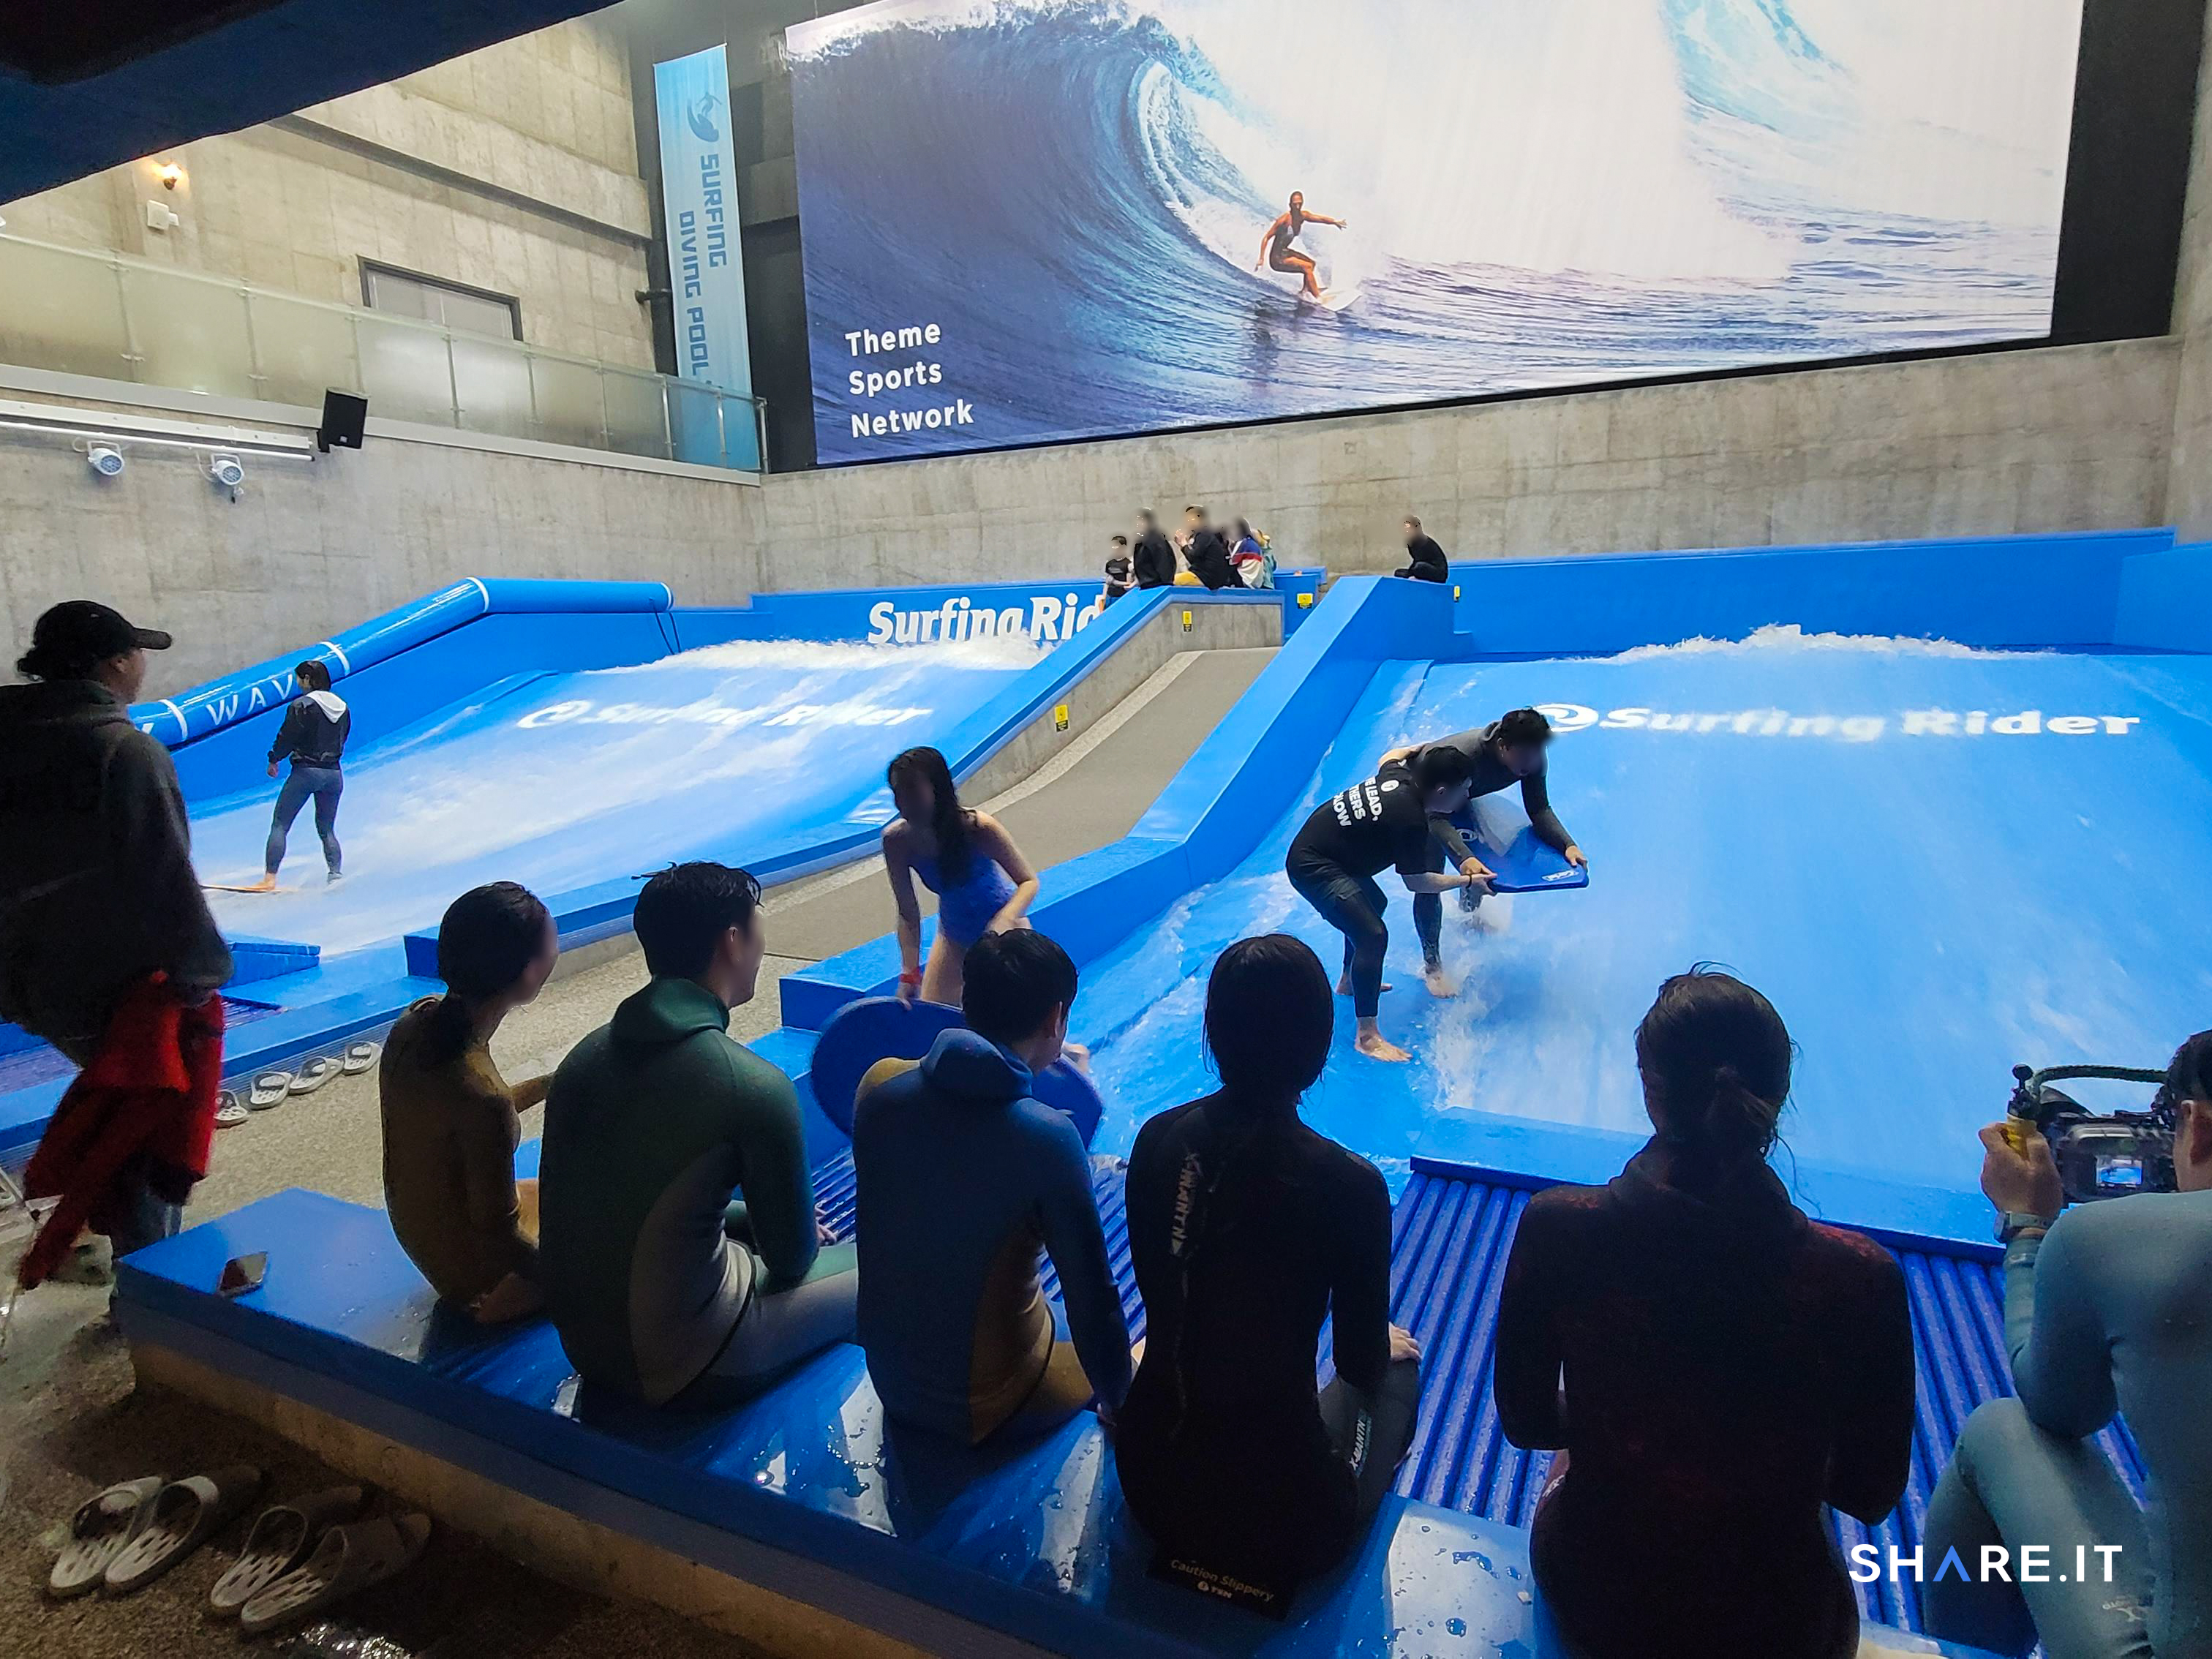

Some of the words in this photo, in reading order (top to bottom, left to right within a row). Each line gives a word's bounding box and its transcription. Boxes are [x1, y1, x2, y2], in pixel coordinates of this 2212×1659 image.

[687, 307, 708, 376] POOL
[844, 323, 941, 356] Theme
[849, 361, 942, 397] Sports
[851, 399, 974, 438] Network
[206, 673, 293, 725] WAV
[1599, 707, 1886, 743] Surfing
[1902, 707, 2140, 736] Rider
[1171, 1559, 1218, 1582] Caution
[1220, 1576, 1274, 1602] Slippery
